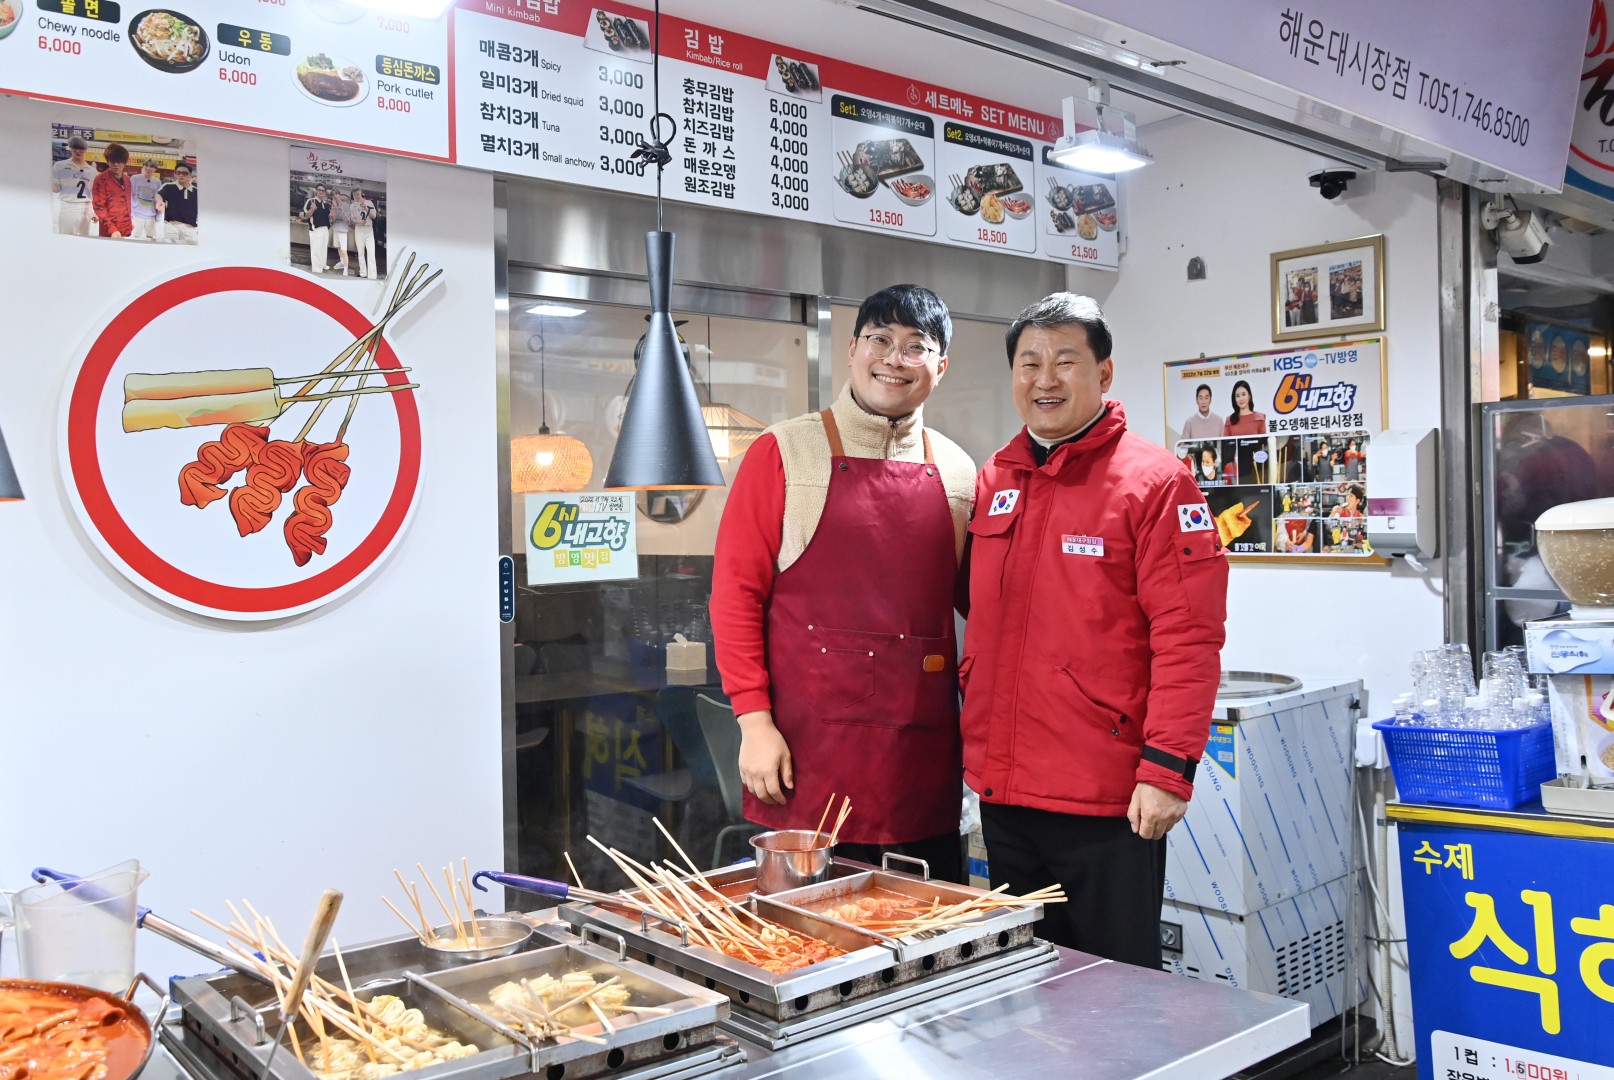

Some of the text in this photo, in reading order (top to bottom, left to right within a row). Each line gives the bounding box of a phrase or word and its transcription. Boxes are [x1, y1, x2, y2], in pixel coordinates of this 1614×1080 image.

[485, 2, 504, 14] Mini
[507, 8, 541, 23] kimbab
[38, 17, 120, 42] Chewy noodle
[38, 36, 81, 55] 6,000
[218, 50, 251, 66] Udon
[381, 57, 436, 83] 등심돈까스
[479, 40, 644, 90] 매콤3개 Spicy 3,000
[686, 50, 743, 71] Kimbab/Rice roll
[219, 67, 257, 86] 6,000
[1279, 8, 1530, 147] 해운대시장점 T.051.746.8500
[377, 80, 434, 100] Pork cutlet
[479, 70, 644, 119] 일미3개 Dried squid 3,000
[682, 78, 808, 119] 충무김밥 6,000
[377, 96, 411, 113] 8,000
[839, 101, 859, 117] Set1.
[925, 90, 974, 118] 세트메뉴
[981, 105, 1006, 124] SET
[1008, 112, 1045, 135] MENU
[480, 102, 644, 148] 참치3개 Tuna 3,000
[683, 97, 808, 138] 참치김밥 4,000
[683, 117, 808, 156] 치즈김밥 4,000
[946, 127, 963, 141] Set2.
[480, 134, 645, 177] 멸치3개 Small anchovy 3,000
[771, 155, 808, 175] 4,000
[683, 157, 809, 193] 매운오뎅 4,000
[76, 180, 86, 199] 2
[684, 176, 809, 211] 원조김밥 3,000
[869, 208, 903, 227] 13,500
[977, 228, 1007, 245] 18,500
[1071, 244, 1098, 260] 21,500
[1273, 355, 1303, 371] KBS
[1300, 382, 1355, 413] 내고향
[1268, 412, 1363, 433] 불오뎅해운대시장점
[563, 516, 627, 549] 내고향
[1246, 746, 1265, 788] WOOSUNG
[1280, 737, 1297, 778] WOOSUNG
[1412, 840, 1475, 881] 수제
